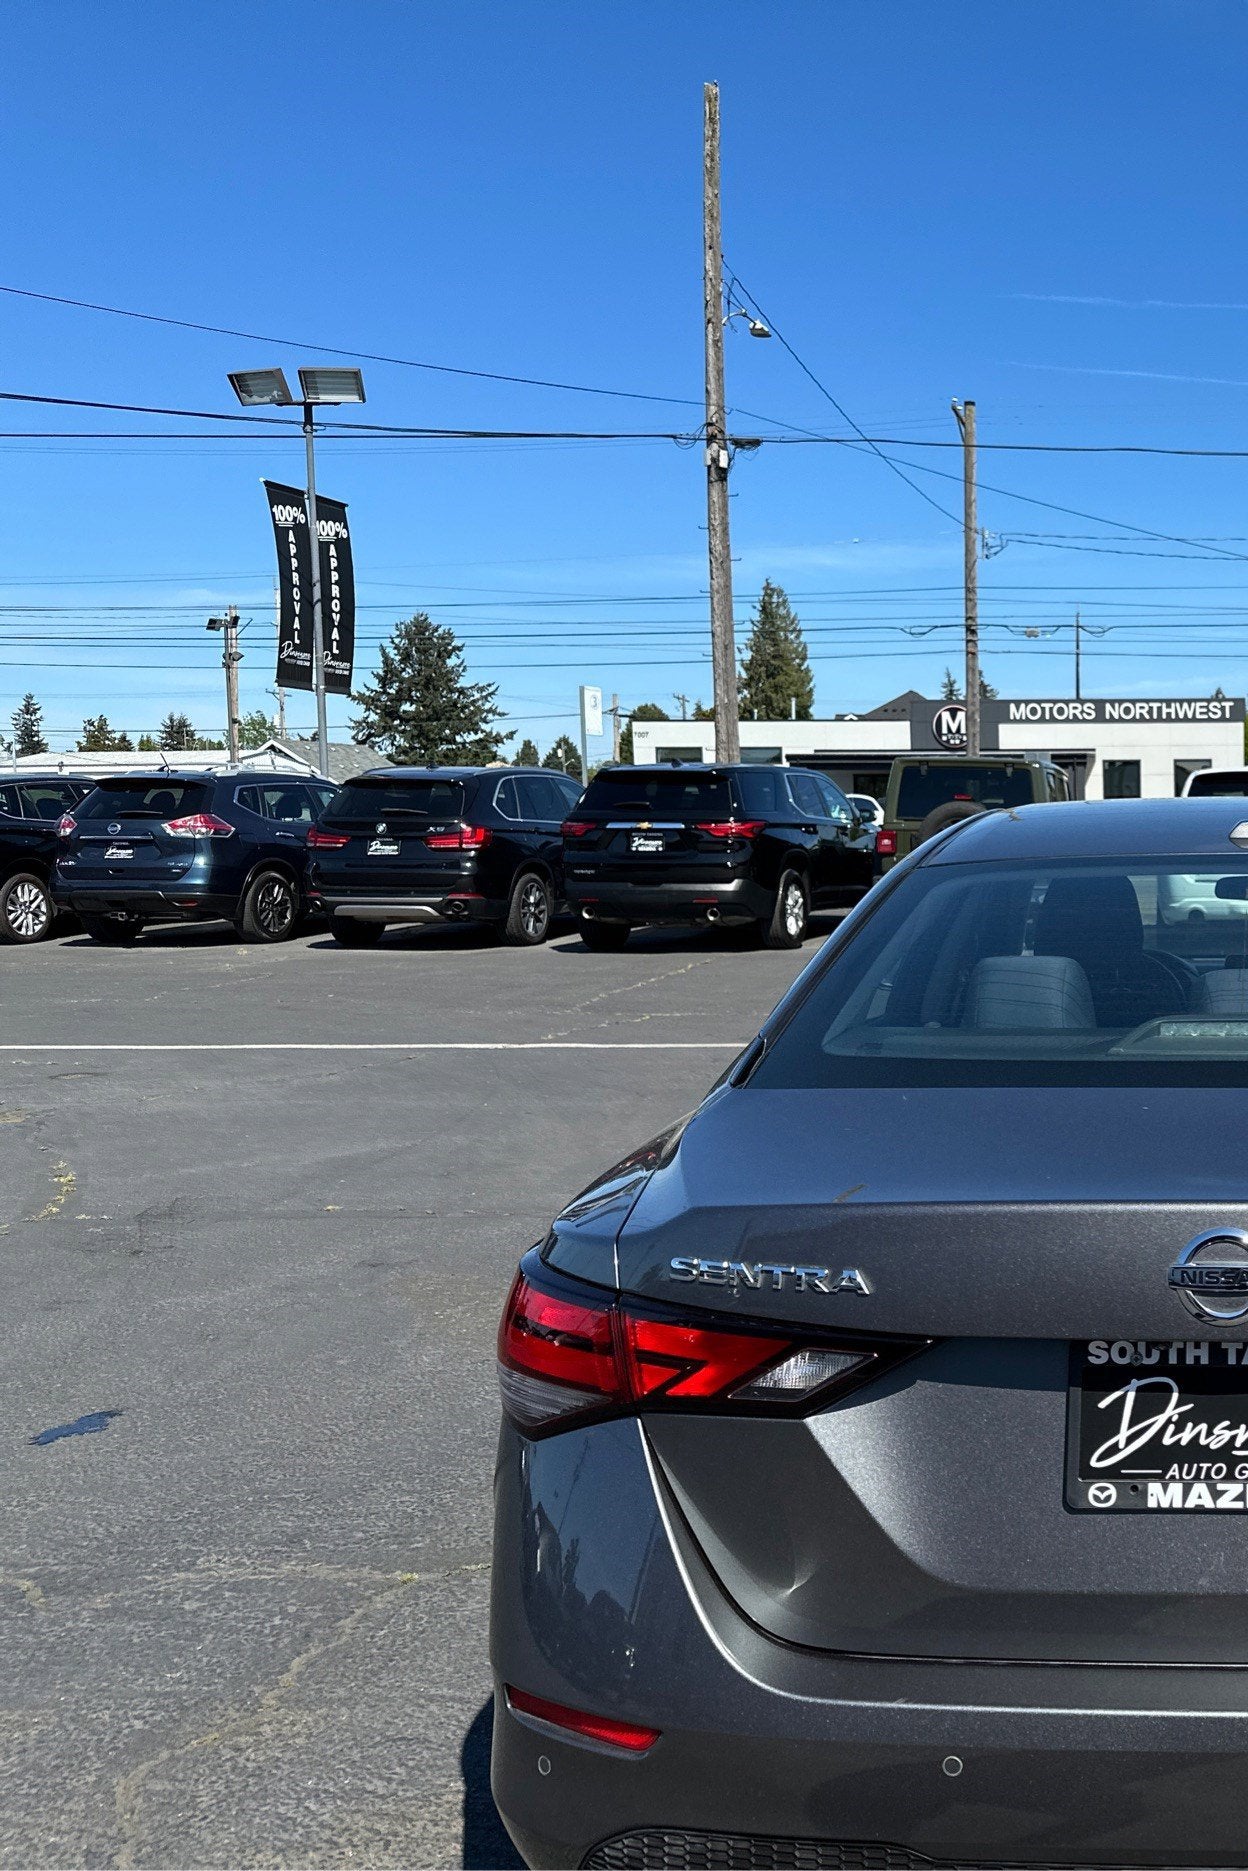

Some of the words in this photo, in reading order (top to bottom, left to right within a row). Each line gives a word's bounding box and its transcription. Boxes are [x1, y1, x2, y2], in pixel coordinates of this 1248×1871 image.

[272, 504, 306, 524] 100%
[316, 520, 348, 539] 100%
[288, 529, 301, 645] APPROVAL
[328, 543, 341, 655] APPROVAL
[941, 710, 967, 734] M
[1009, 702, 1096, 721] MOTORS
[1105, 701, 1235, 720] NORTHWEST
[669, 1257, 870, 1295] SENTRA
[1087, 1340, 1210, 1367] SOUTH
[1165, 1463, 1228, 1480] AUTO
